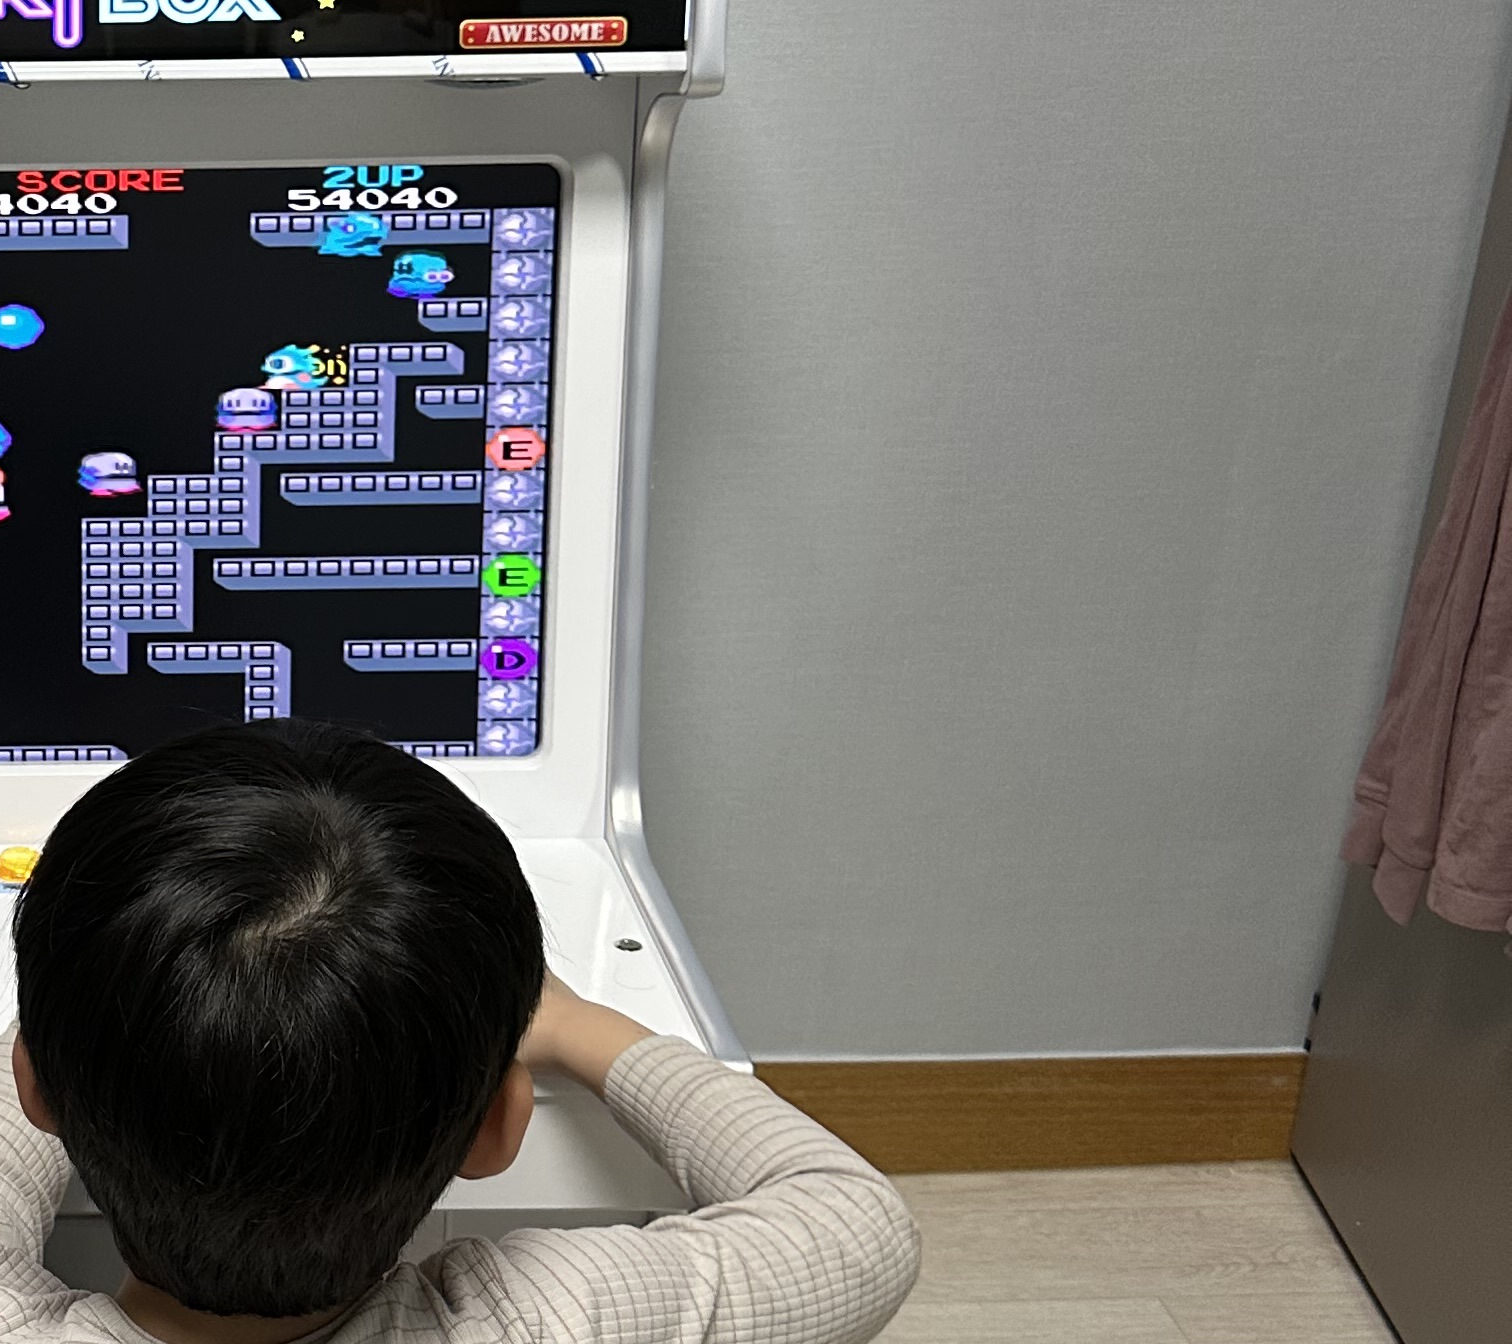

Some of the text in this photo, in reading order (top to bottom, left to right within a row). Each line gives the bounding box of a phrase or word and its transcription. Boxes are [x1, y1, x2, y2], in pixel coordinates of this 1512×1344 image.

[485, 22, 606, 43] AWESOME
[17, 169, 185, 192] SCORE
[322, 164, 424, 188] 2UP
[287, 186, 458, 211] 54040
[502, 440, 533, 460] E
[498, 567, 529, 587] E
[495, 649, 527, 670] D
